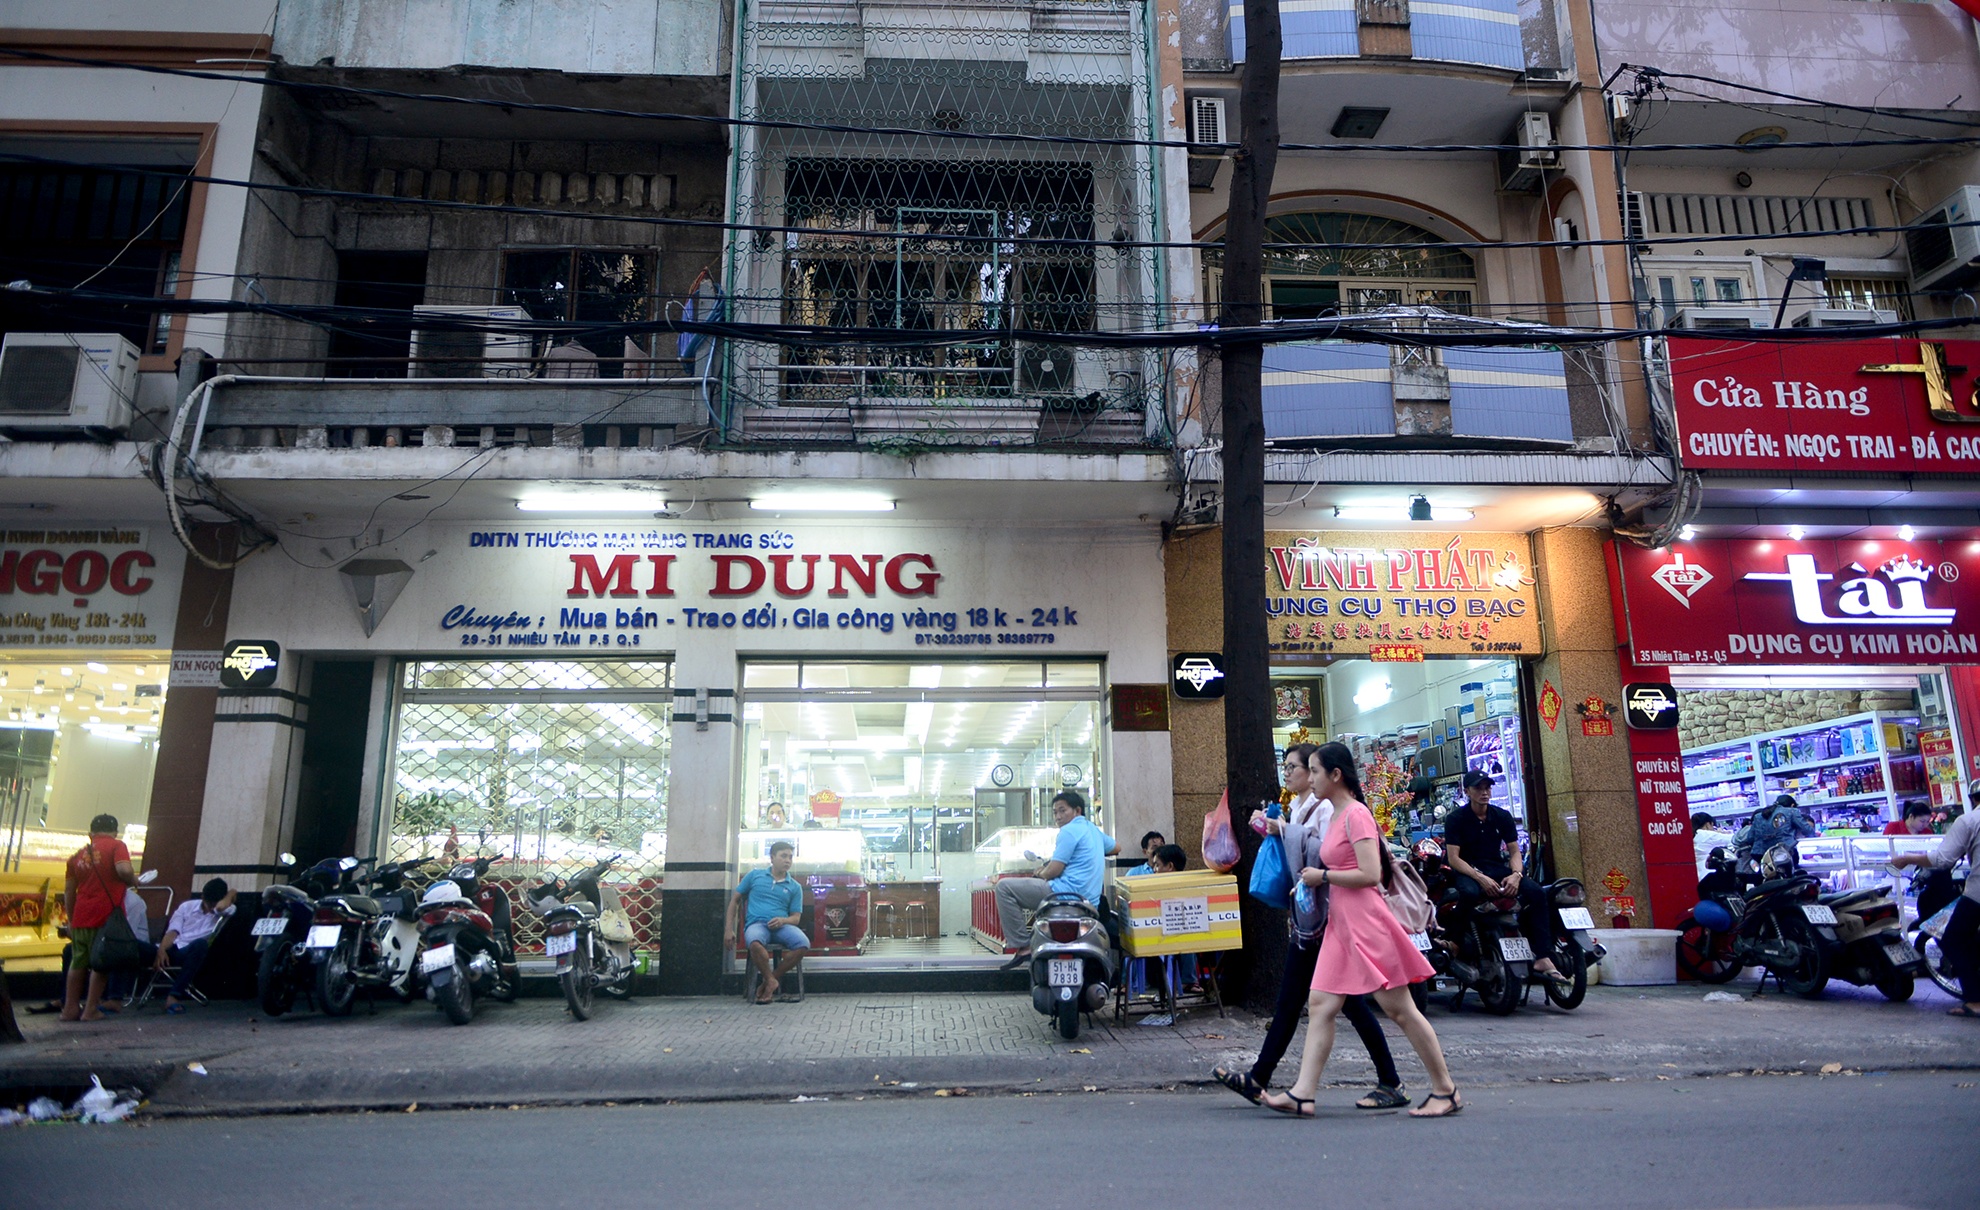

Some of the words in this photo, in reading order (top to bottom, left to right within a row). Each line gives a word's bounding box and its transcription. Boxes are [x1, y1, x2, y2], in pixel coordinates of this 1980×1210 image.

[1693, 376, 1764, 408] Cửa
[1772, 381, 1871, 416] Hàng
[1784, 433, 1841, 462] NGỌC
[1846, 435, 1896, 459] TRAI
[1911, 431, 1941, 459] ĐÁ
[7, 530, 45, 543] KINH
[46, 530, 99, 543] DOANH
[101, 527, 140, 544] VÀNG
[470, 532, 519, 548] DNTN
[525, 529, 598, 548] THƯƠNG
[603, 532, 636, 551] MẠI
[640, 529, 687, 548] VÀNG
[693, 532, 752, 549] TRANG
[759, 529, 794, 549] SỨC
[1270, 536, 1379, 592] VĨNH
[1384, 535, 1496, 592] PHÁT
[567, 554, 676, 597] MI
[708, 552, 941, 598] DUNG
[1265, 596, 1330, 618] ỤNG
[1339, 597, 1383, 619] CỤ
[1394, 595, 1458, 619] THỢ
[1467, 597, 1527, 622] BẠC
[560, 607, 607, 628] Mua
[615, 606, 658, 628] bán
[683, 607, 736, 628] Trao
[836, 607, 894, 633] công
[901, 607, 957, 632] vàng
[508, 631, 548, 645] NHIÊU
[553, 630, 581, 645] TÂM
[590, 633, 610, 645] P.5
[1728, 633, 1803, 659] DỤNG
[1810, 633, 1844, 659] CỤ
[1851, 634, 1900, 655] KIM
[1906, 629, 1978, 655] HOÀN
[1640, 650, 1651, 661] 35
[173, 660, 193, 671] KIM
[1636, 758, 1670, 773] CHUYÊN
[1653, 781, 1682, 794] TRANG
[1654, 801, 1673, 816] BẠC
[1648, 822, 1666, 835] CAO
[1666, 817, 1684, 835] CẤP
[1219, 912, 1238, 920] LCL
[1053, 973, 1078, 984] 7838
